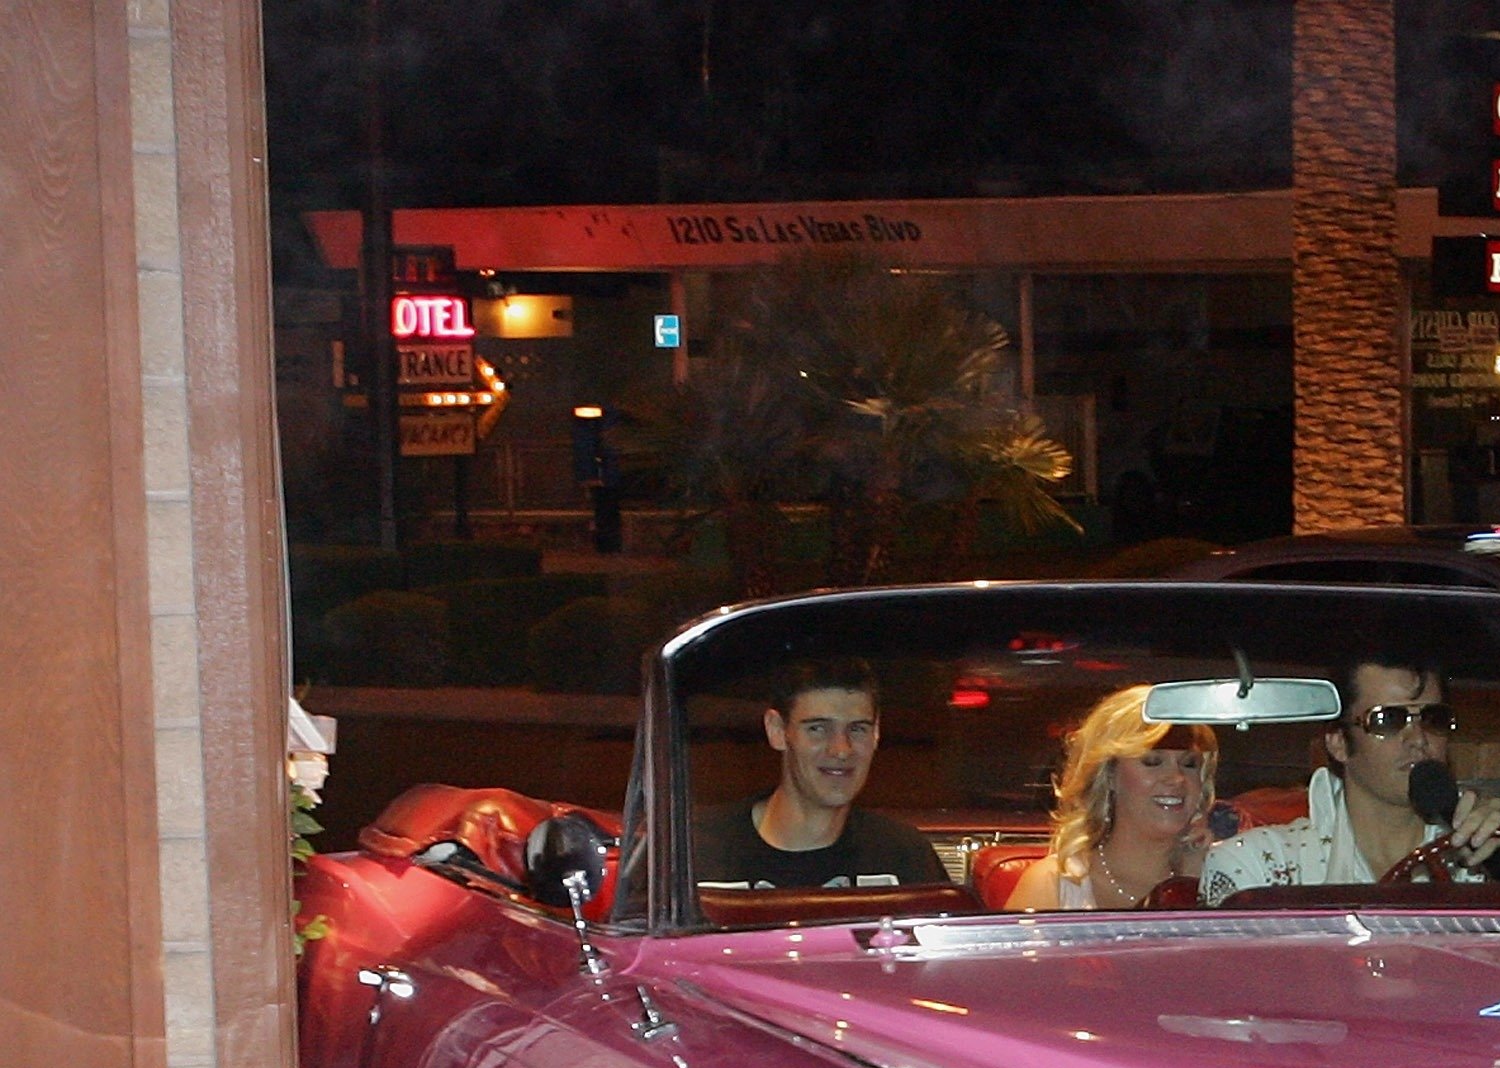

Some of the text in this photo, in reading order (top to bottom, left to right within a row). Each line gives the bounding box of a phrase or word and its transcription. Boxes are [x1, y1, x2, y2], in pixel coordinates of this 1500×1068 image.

[667, 215, 723, 244] 1210
[394, 297, 476, 338] OTEL
[399, 349, 467, 377] TRANCE
